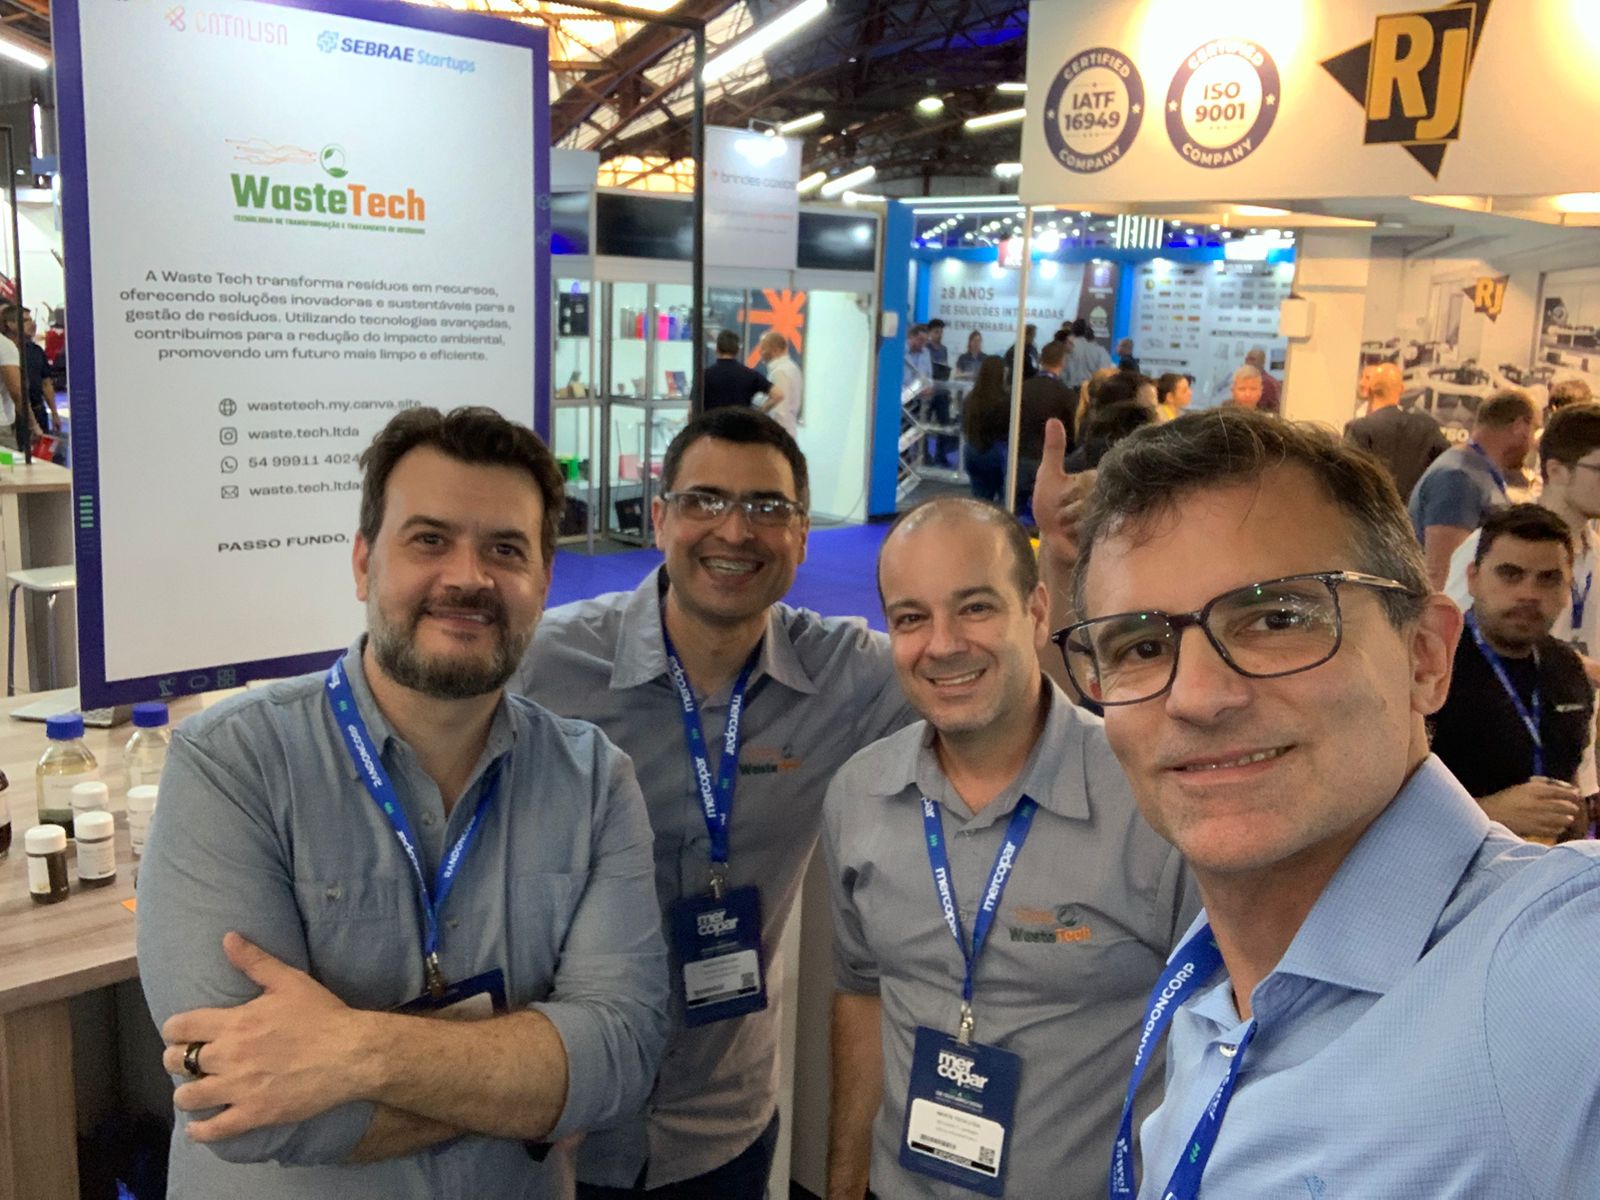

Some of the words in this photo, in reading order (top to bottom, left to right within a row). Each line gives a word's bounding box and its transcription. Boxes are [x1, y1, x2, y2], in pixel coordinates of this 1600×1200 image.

[340, 37, 416, 63] SEBRAE
[416, 49, 476, 74] Startups
[1063, 52, 1131, 80] CERTIFIED
[1368, 14, 1469, 140] RJ
[1072, 91, 1116, 110] IATF
[1204, 81, 1241, 100] ISO
[1064, 111, 1121, 131] 16949
[1195, 102, 1246, 123] 9001
[1058, 145, 1121, 170] COMPANY
[1182, 138, 1253, 166] COMPANY
[145, 270, 158, 282] A
[161, 270, 213, 285] Waste
[216, 272, 252, 286] Tech
[256, 274, 344, 290] transforma
[347, 279, 409, 293] resíduos
[412, 284, 433, 294] em
[435, 285, 499, 298] recursos,
[960, 286, 995, 301] ANOS
[1475, 276, 1504, 315] RJ
[119, 288, 216, 302] oferecendo
[219, 291, 288, 307] soluções
[290, 294, 373, 309] inovadoras
[376, 300, 384, 308] e
[387, 299, 473, 312] sustentáveis
[475, 303, 505, 314] para
[507, 304, 515, 313] a
[125, 308, 181, 324] gestão
[185, 309, 205, 322] de
[208, 310, 282, 324] resíduos.
[285, 311, 357, 325] Utilizando
[359, 315, 438, 329] tecnologias
[440, 317, 512, 331] avançadas,
[246, 331, 283, 343] para
[286, 332, 296, 341] a
[299, 330, 360, 345] redução
[362, 331, 381, 343] do
[384, 333, 438, 346] impacto
[440, 334, 506, 346] ambiental,
[158, 347, 262, 361] promovendo
[264, 349, 289, 359] um
[292, 347, 341, 360] futuro
[343, 348, 377, 360] mais
[380, 349, 417, 362] limpo
[419, 351, 428, 360] e
[430, 349, 489, 361] eficiente.
[248, 426, 360, 440] waste.tech.ltda
[248, 456, 268, 468] 54
[272, 455, 319, 467] 99911
[248, 480, 361, 496] waste.tech.ltda
[217, 538, 281, 552] PASSO
[670, 655, 694, 713] mercopar
[724, 693, 742, 756] mercopar
[347, 724, 383, 788] RANDONCORP
[695, 756, 717, 819] mercopar
[982, 841, 1017, 912] mercopar
[935, 867, 959, 938] mercopar
[1134, 961, 1196, 1066] RANDONCORP
[938, 1051, 976, 1073] mer
[937, 1064, 989, 1089] copar
